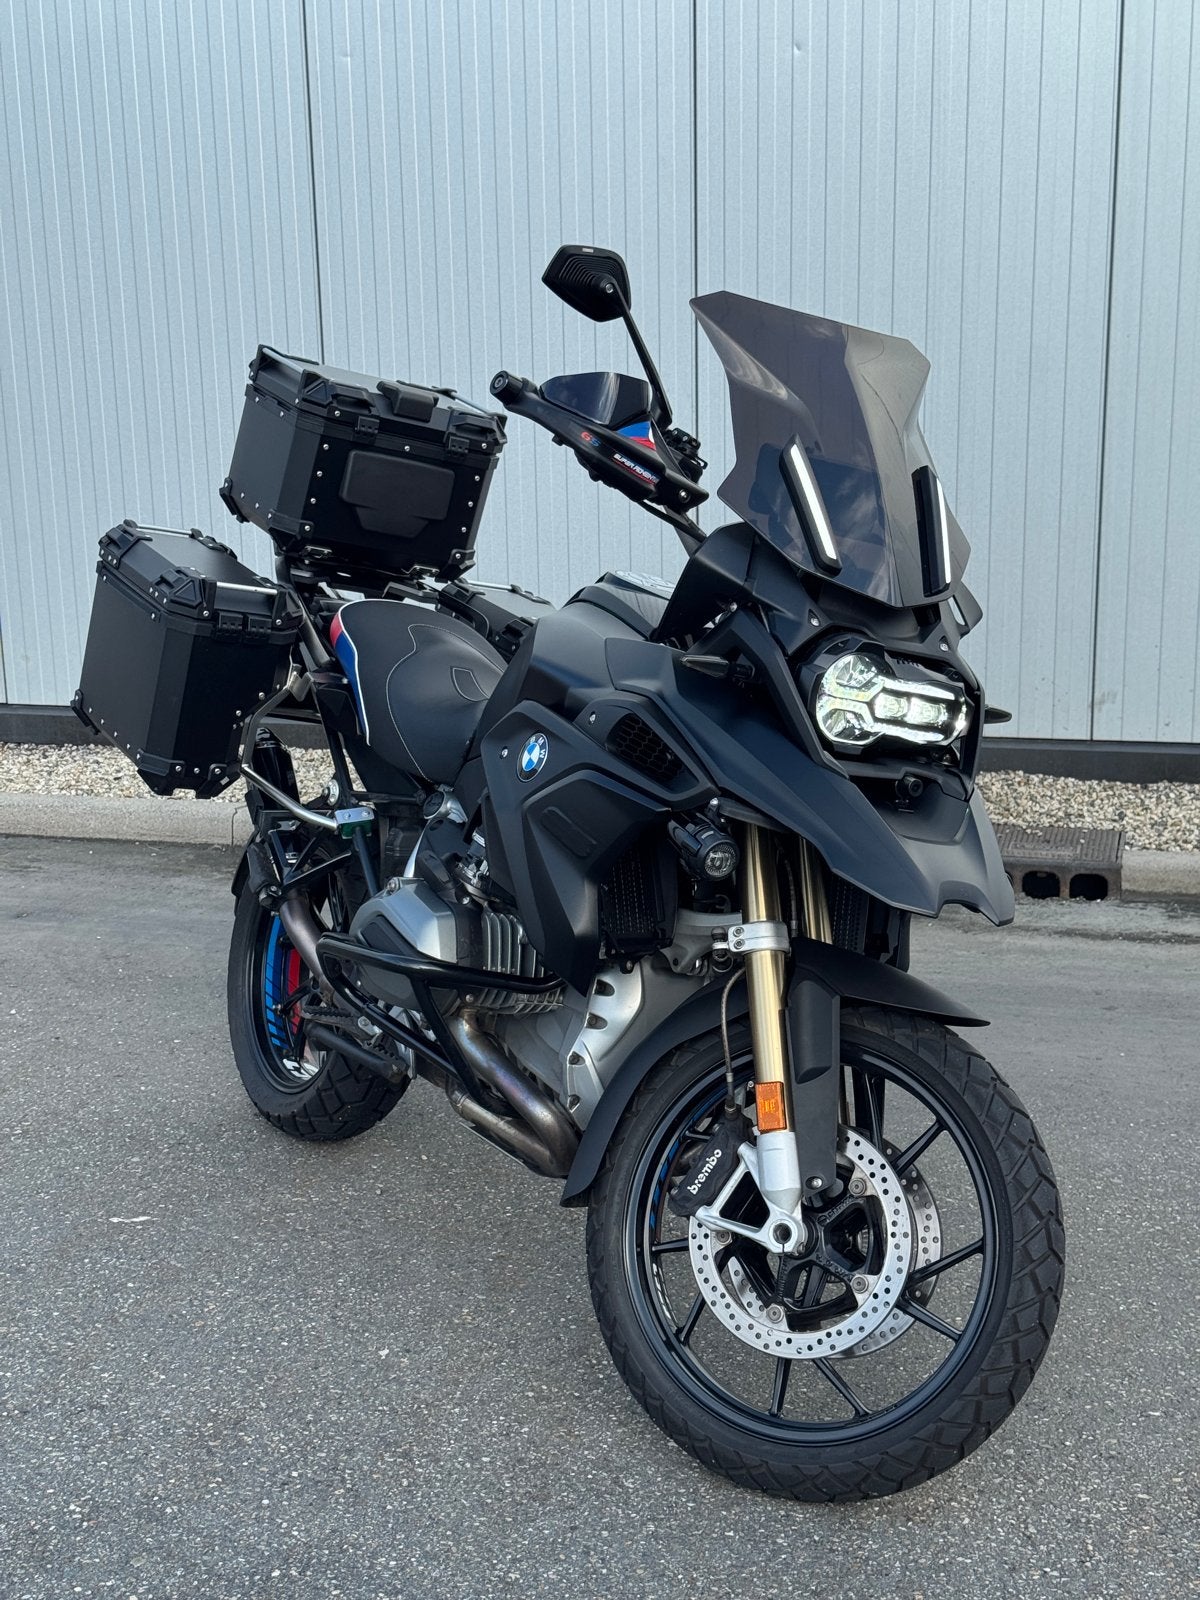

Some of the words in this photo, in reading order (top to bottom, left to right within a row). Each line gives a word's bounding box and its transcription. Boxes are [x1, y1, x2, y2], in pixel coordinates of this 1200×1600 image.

[581, 431, 601, 447] GS
[530, 736, 546, 759] BMW
[687, 1149, 722, 1195] brembo
